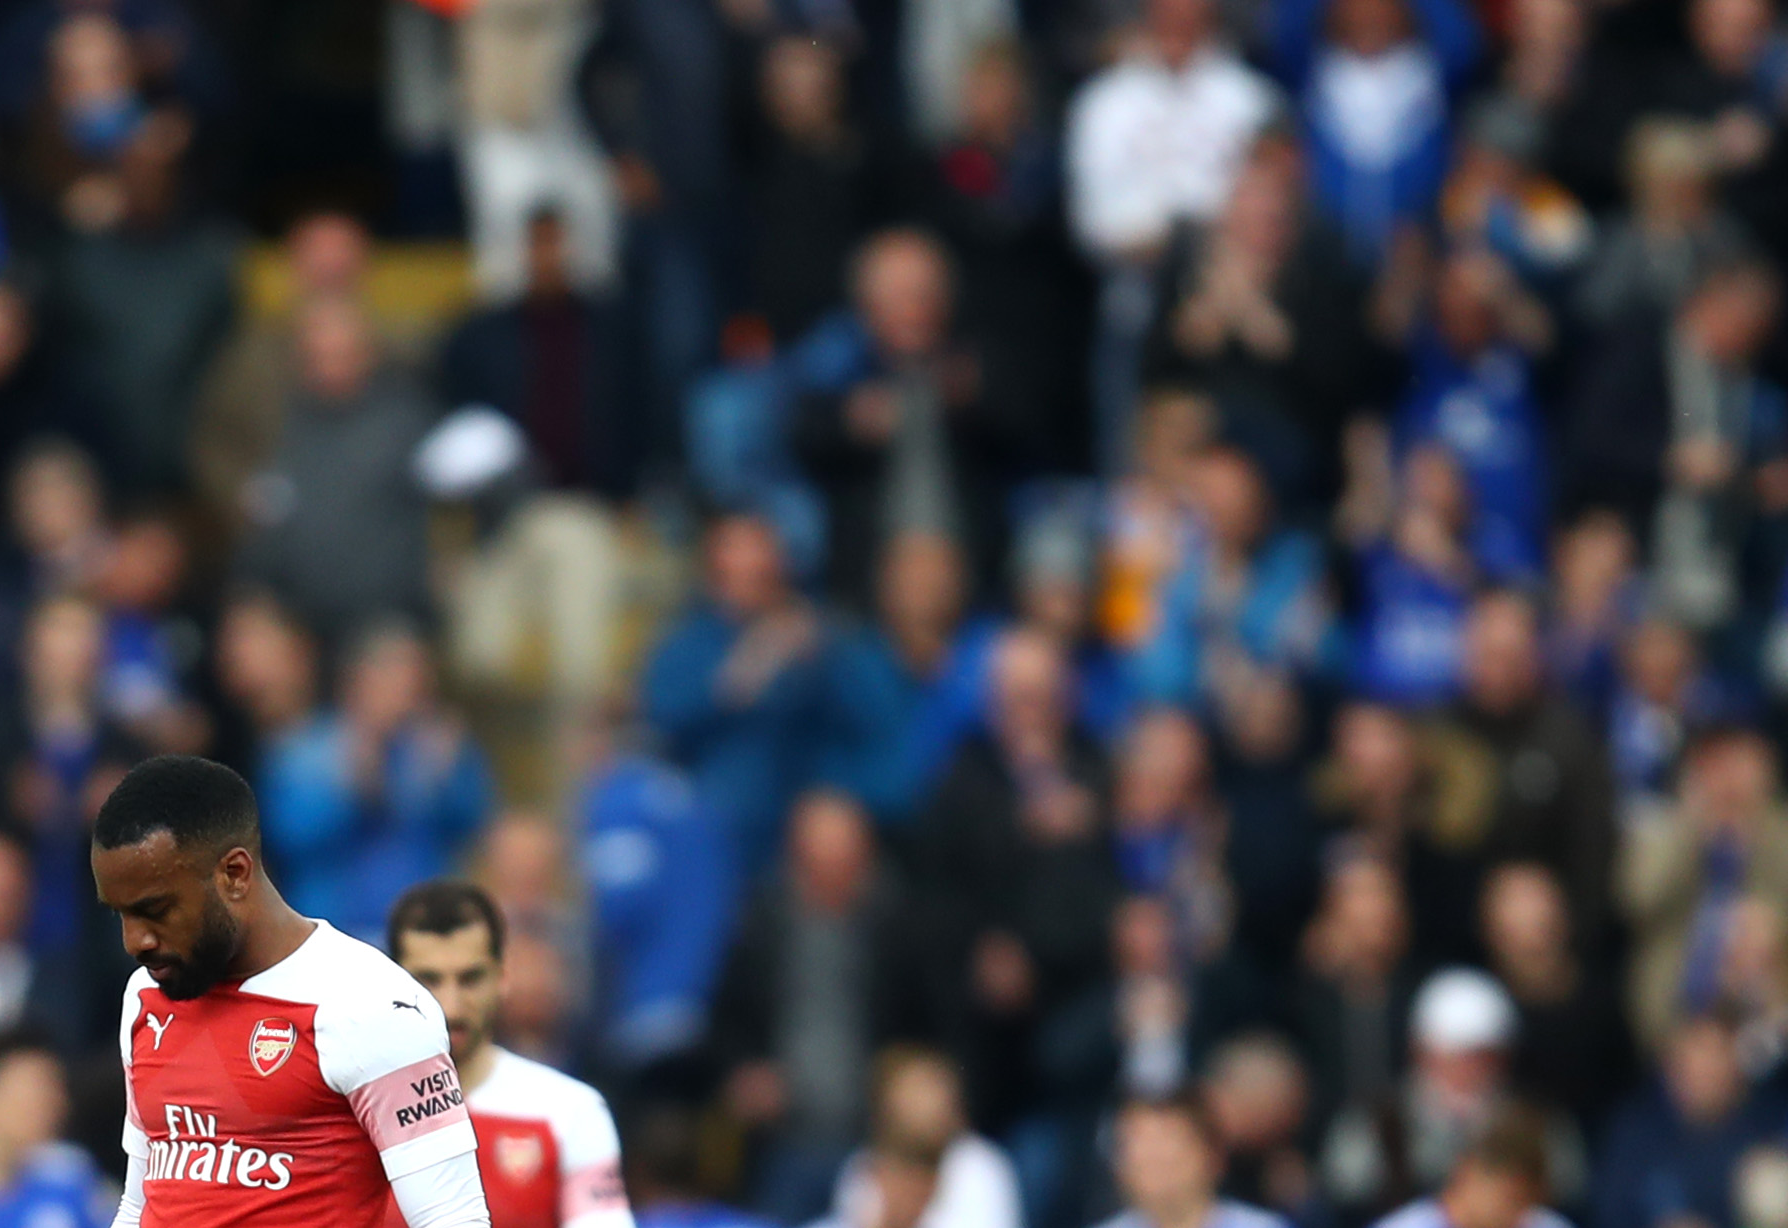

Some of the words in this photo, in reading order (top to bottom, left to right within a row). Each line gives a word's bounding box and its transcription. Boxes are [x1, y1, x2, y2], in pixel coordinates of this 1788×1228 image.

[410, 1069, 454, 1098] VISIT
[164, 1104, 217, 1138] Fly
[396, 1088, 465, 1128] RWAND
[144, 1133, 294, 1191] mirates
